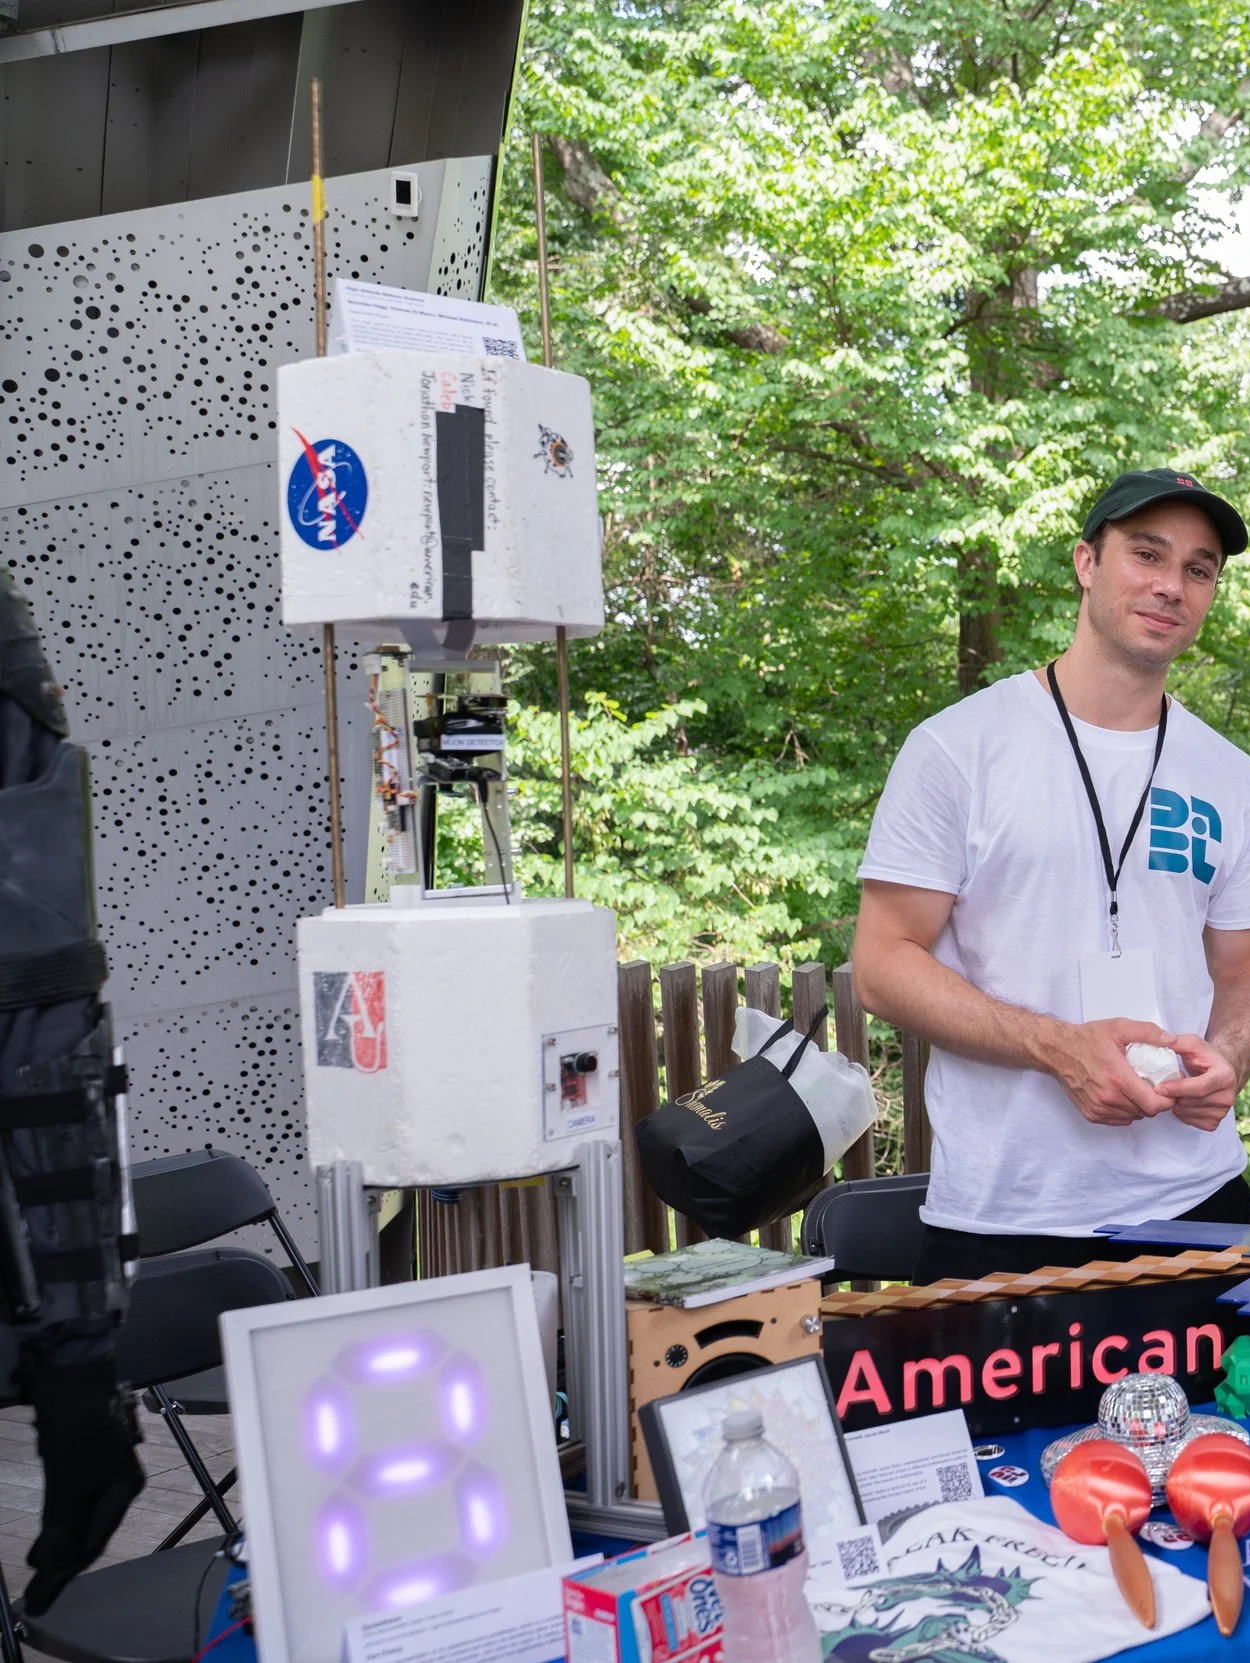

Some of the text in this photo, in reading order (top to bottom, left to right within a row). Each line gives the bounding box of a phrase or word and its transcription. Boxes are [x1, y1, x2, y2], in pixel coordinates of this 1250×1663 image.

[460, 372, 476, 402] Nick
[318, 444, 337, 542] NASA
[836, 1322, 1223, 1420] American
